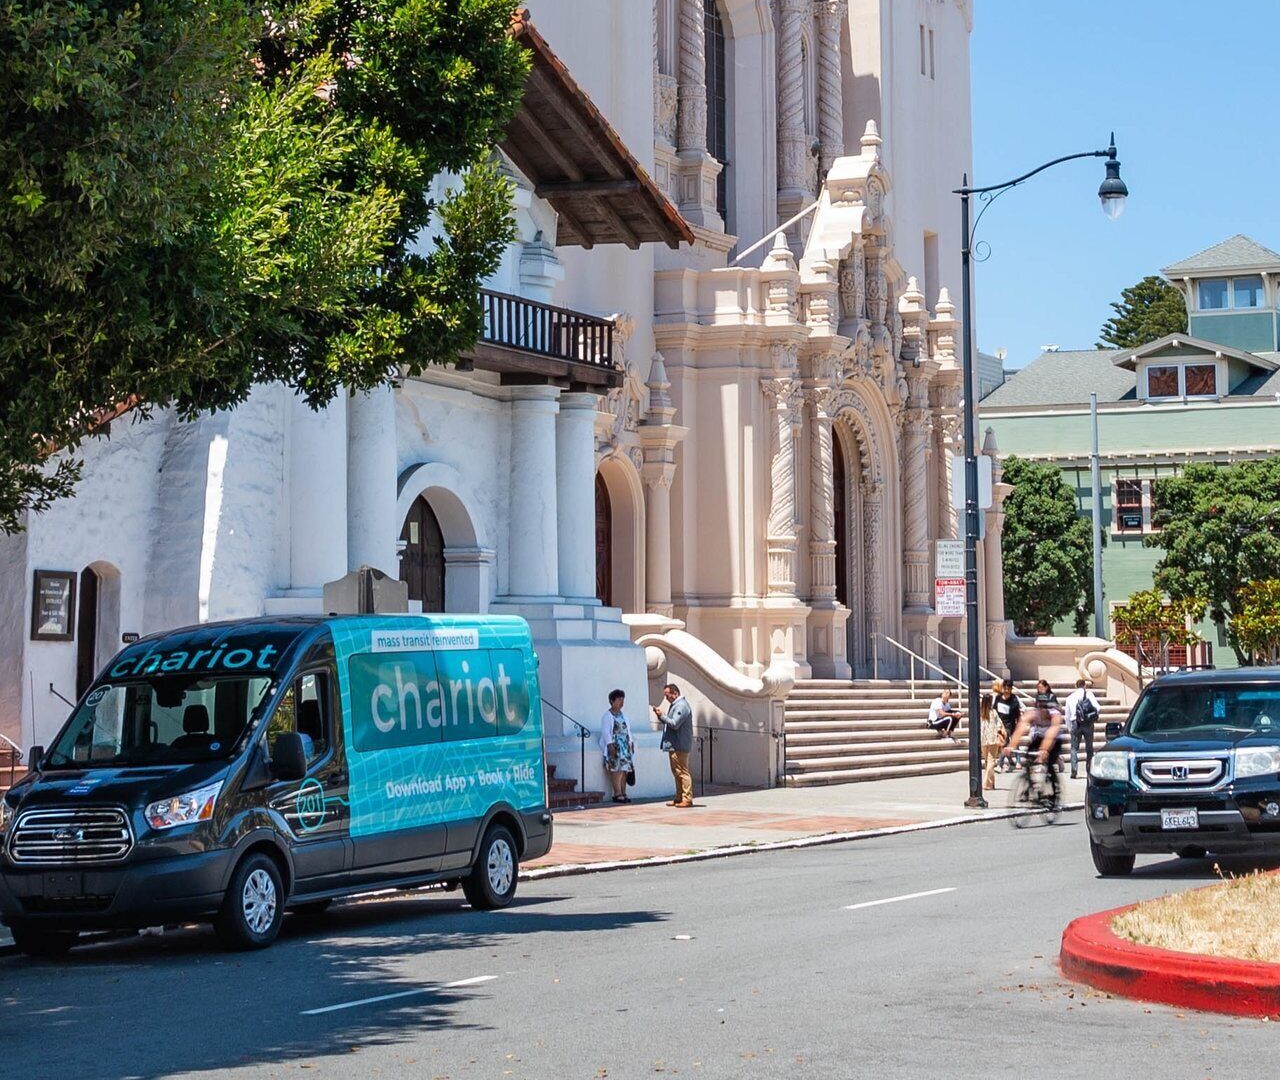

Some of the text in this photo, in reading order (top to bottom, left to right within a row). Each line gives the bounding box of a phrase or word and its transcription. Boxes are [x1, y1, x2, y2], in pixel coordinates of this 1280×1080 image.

[377, 633, 474, 647] mass transit reinvented
[110, 642, 278, 678] chariot
[371, 660, 515, 733] chariot
[386, 764, 534, 799] Download App Book Ride
[301, 794, 320, 814] 201
